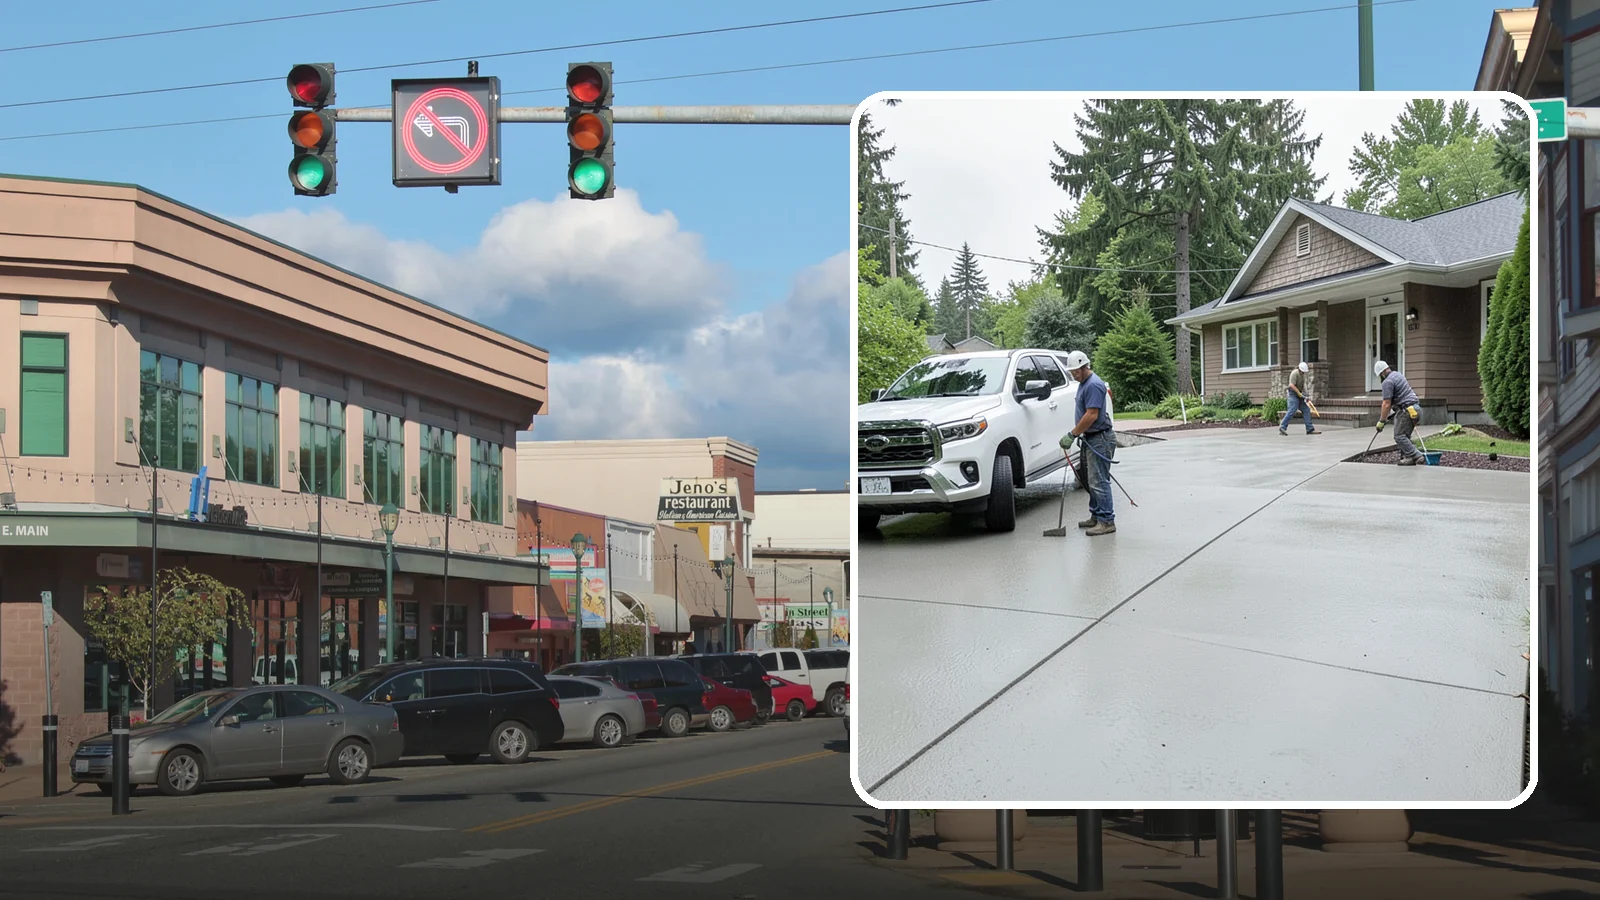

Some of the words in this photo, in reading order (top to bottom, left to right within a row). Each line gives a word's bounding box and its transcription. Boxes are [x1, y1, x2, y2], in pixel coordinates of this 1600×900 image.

[670, 480, 727, 494] Jeno's
[665, 496, 731, 509] restaurant
[659, 510, 682, 519] Italian
[686, 510, 714, 519] American
[715, 509, 738, 519] Cuisine
[2, 525, 13, 536] E.
[15, 525, 49, 536] MAIN
[797, 607, 828, 617] Street
[790, 619, 824, 627] lass
